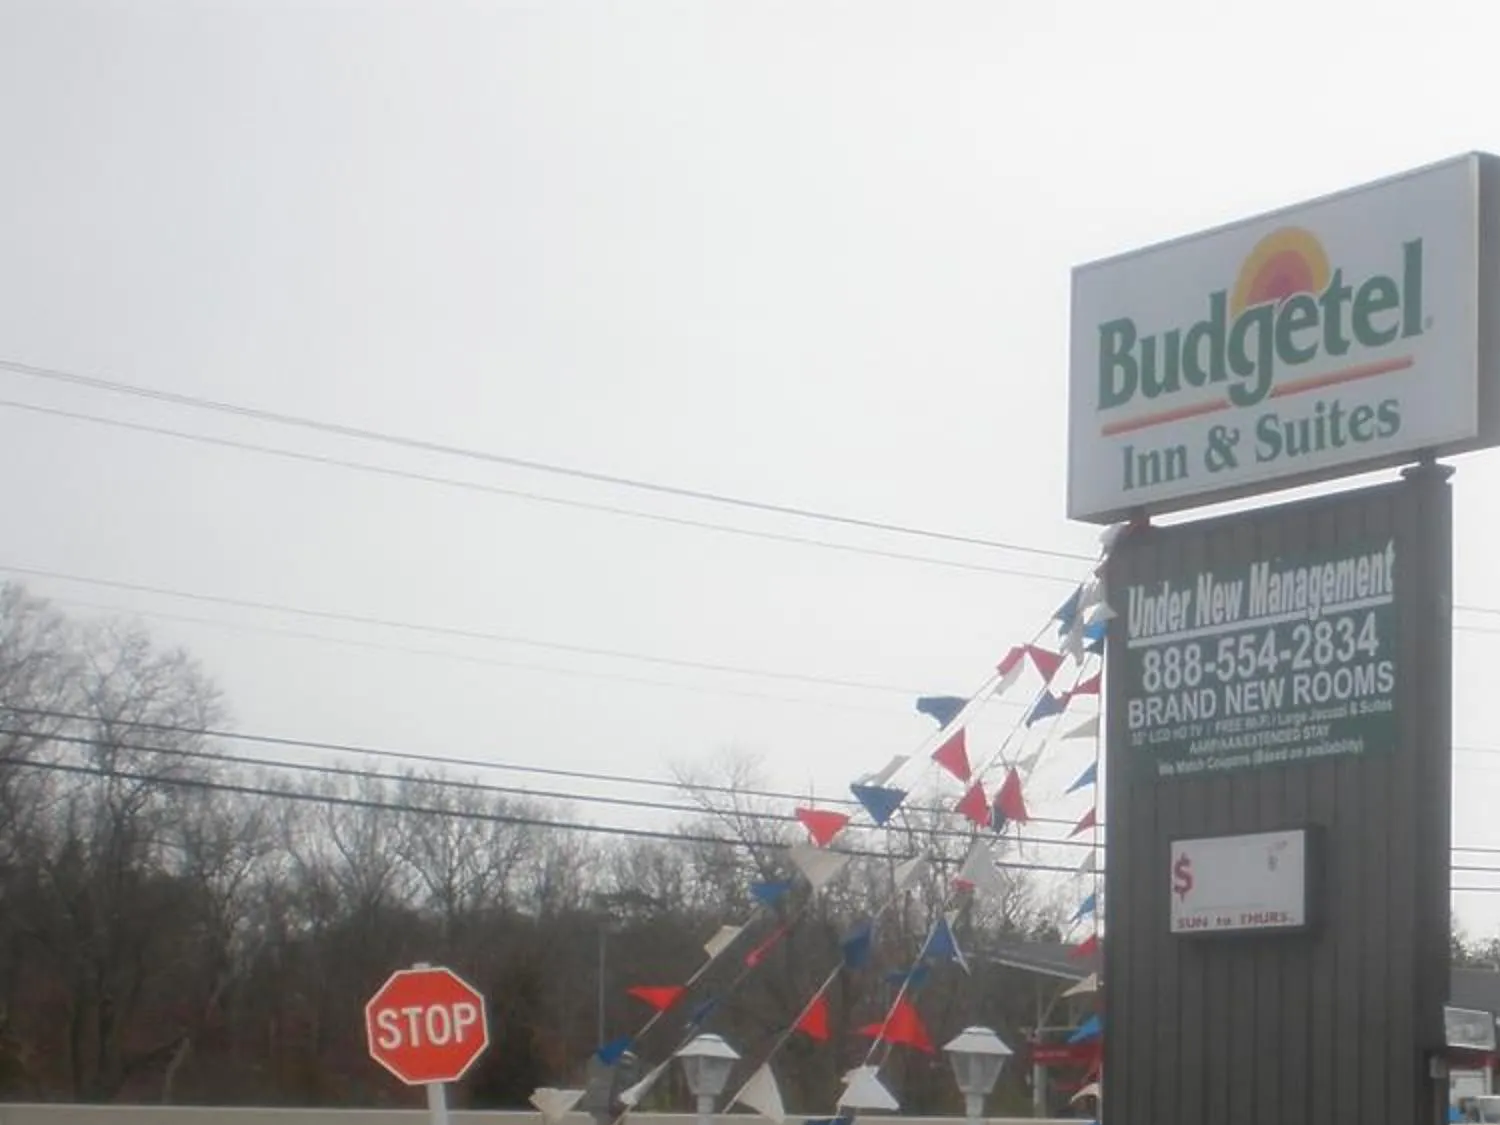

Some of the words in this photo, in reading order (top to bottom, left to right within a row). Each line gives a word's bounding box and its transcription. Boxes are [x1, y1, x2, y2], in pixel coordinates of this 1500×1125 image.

[1097, 237, 1424, 407] Budgetel
[1122, 442, 1189, 491] Inn
[1204, 424, 1241, 474] &
[1255, 399, 1400, 463] Suites
[1128, 580, 1192, 638] Under
[1195, 571, 1243, 626] New
[1249, 540, 1395, 621] Management
[1142, 611, 1379, 692] 888-554-2834
[1128, 688, 1217, 730] BRAND
[1225, 677, 1285, 717] NEW
[1293, 660, 1394, 704] ROOMS
[376, 1002, 478, 1049] STOP
